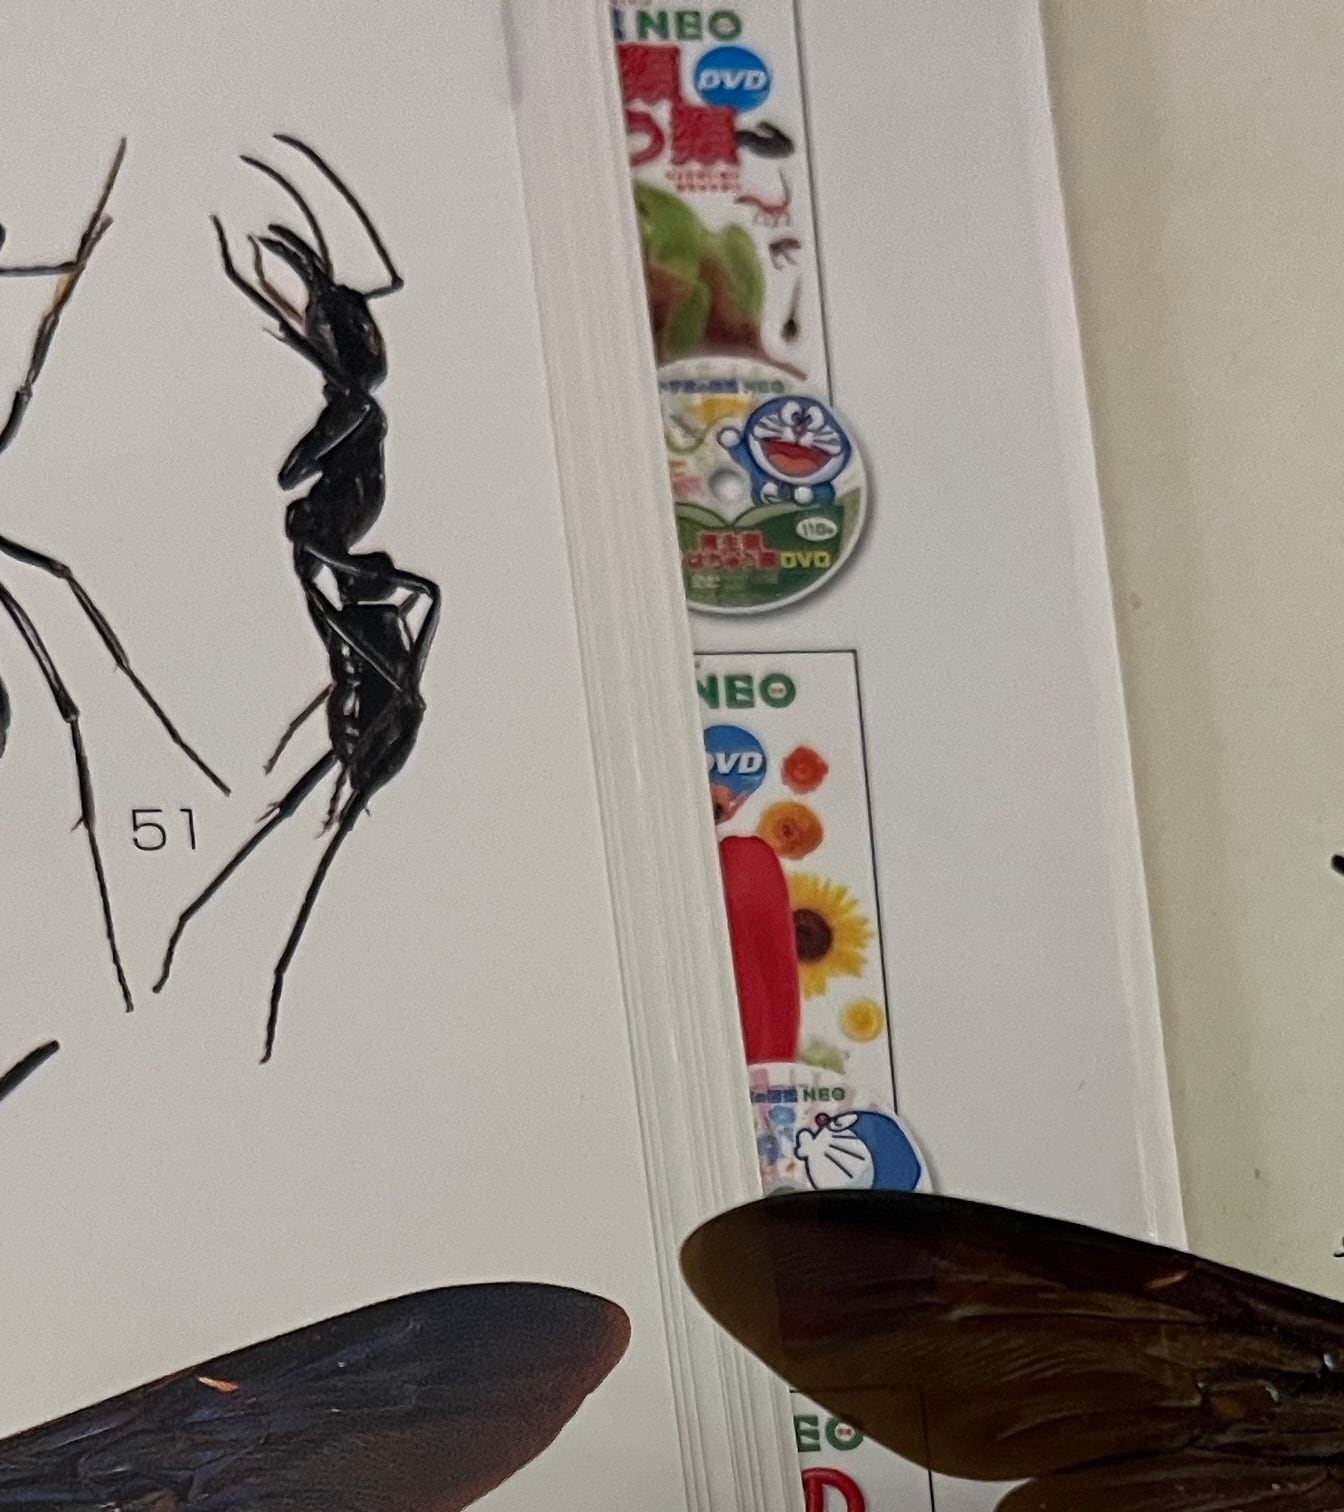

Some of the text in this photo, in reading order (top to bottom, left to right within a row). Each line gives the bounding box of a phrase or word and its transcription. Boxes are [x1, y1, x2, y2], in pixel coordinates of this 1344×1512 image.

[637, 9, 742, 41] NEO
[697, 69, 768, 91] DVD
[131, 808, 197, 852] 51
